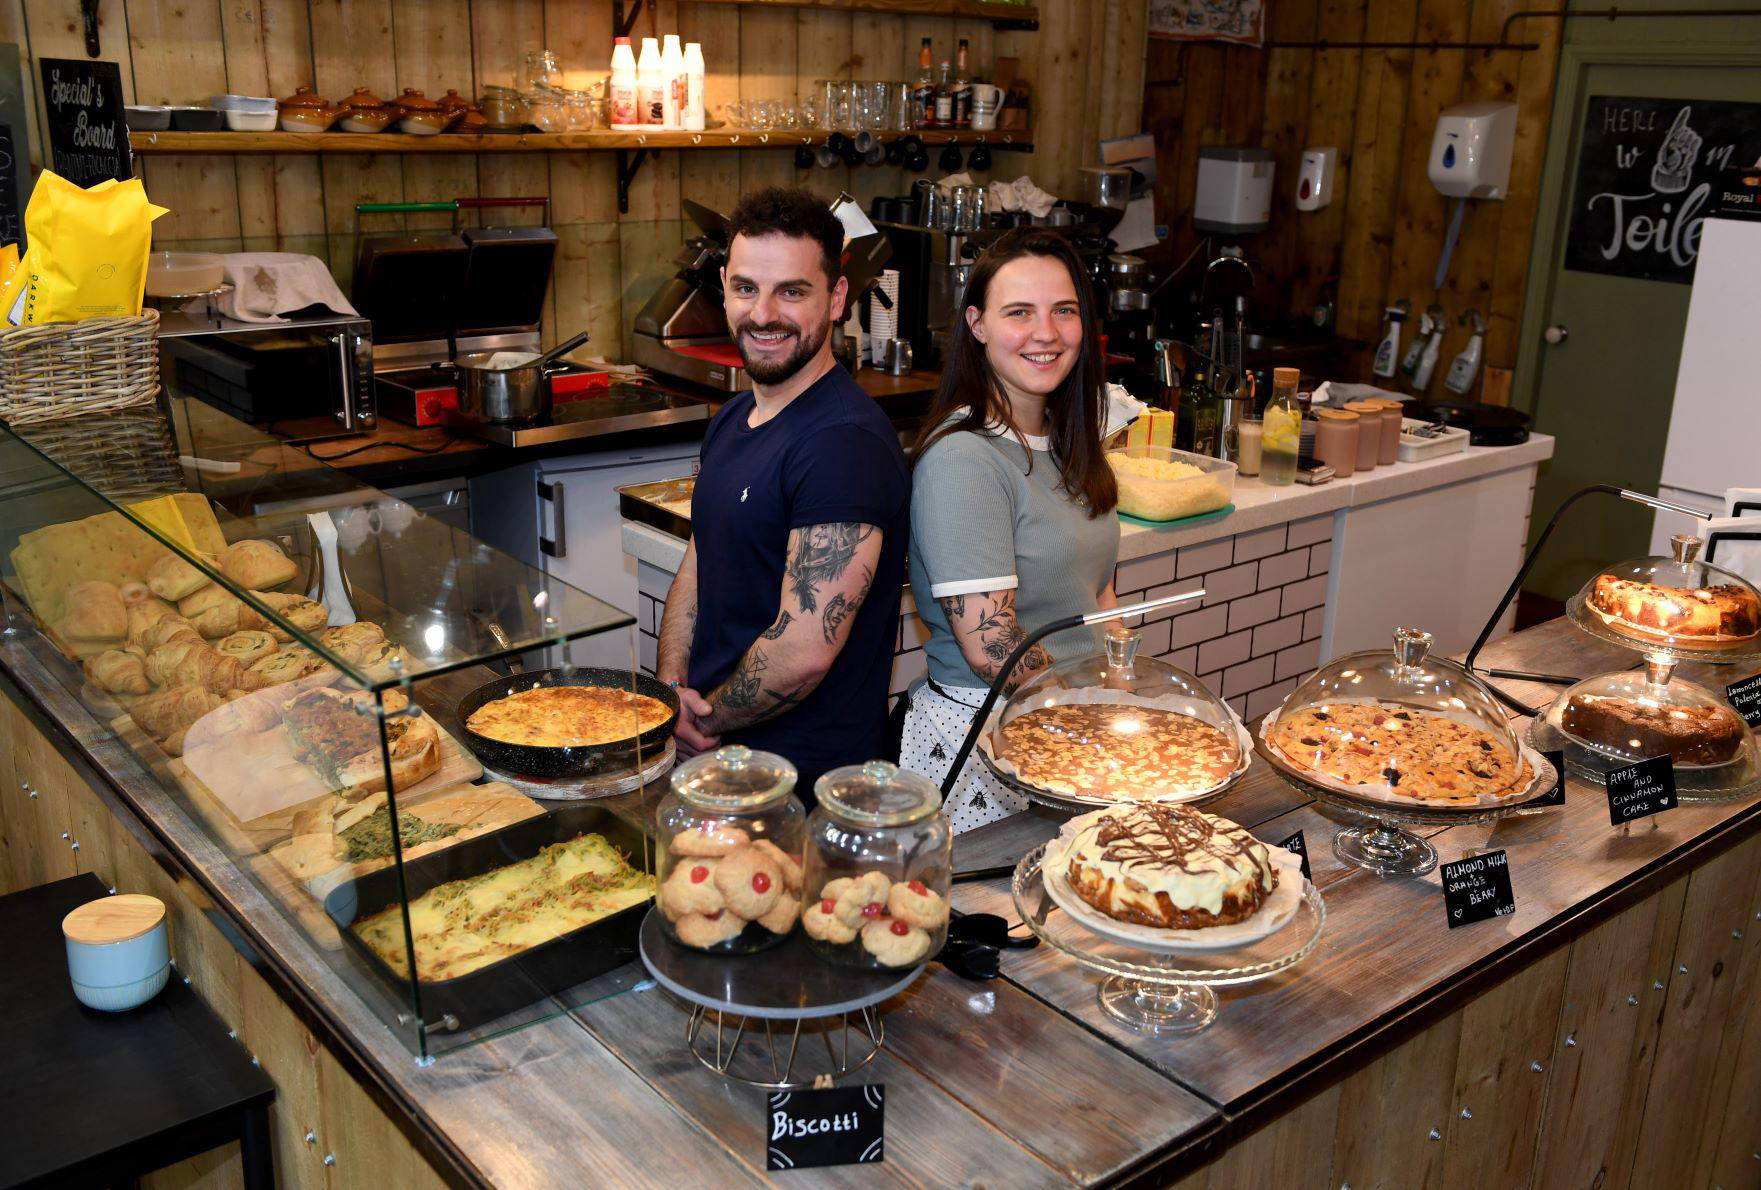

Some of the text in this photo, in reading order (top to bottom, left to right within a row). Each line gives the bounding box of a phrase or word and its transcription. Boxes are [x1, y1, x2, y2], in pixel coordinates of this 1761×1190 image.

[51, 69, 104, 112] Special's
[73, 110, 116, 150] Board
[1722, 192, 1754, 203] Royal
[1588, 183, 1711, 266] Toile
[27, 274, 39, 323] DARKW
[1610, 767, 1638, 785] APPLE
[1634, 775, 1652, 788] AND
[1612, 784, 1664, 805] CINNAMON
[1623, 802, 1649, 816] CAKE
[1446, 853, 1507, 879] ALMOND MILK
[1449, 876, 1486, 892] ORANGE
[1469, 886, 1496, 905] BERRY
[771, 1110, 859, 1141] Biscotti
